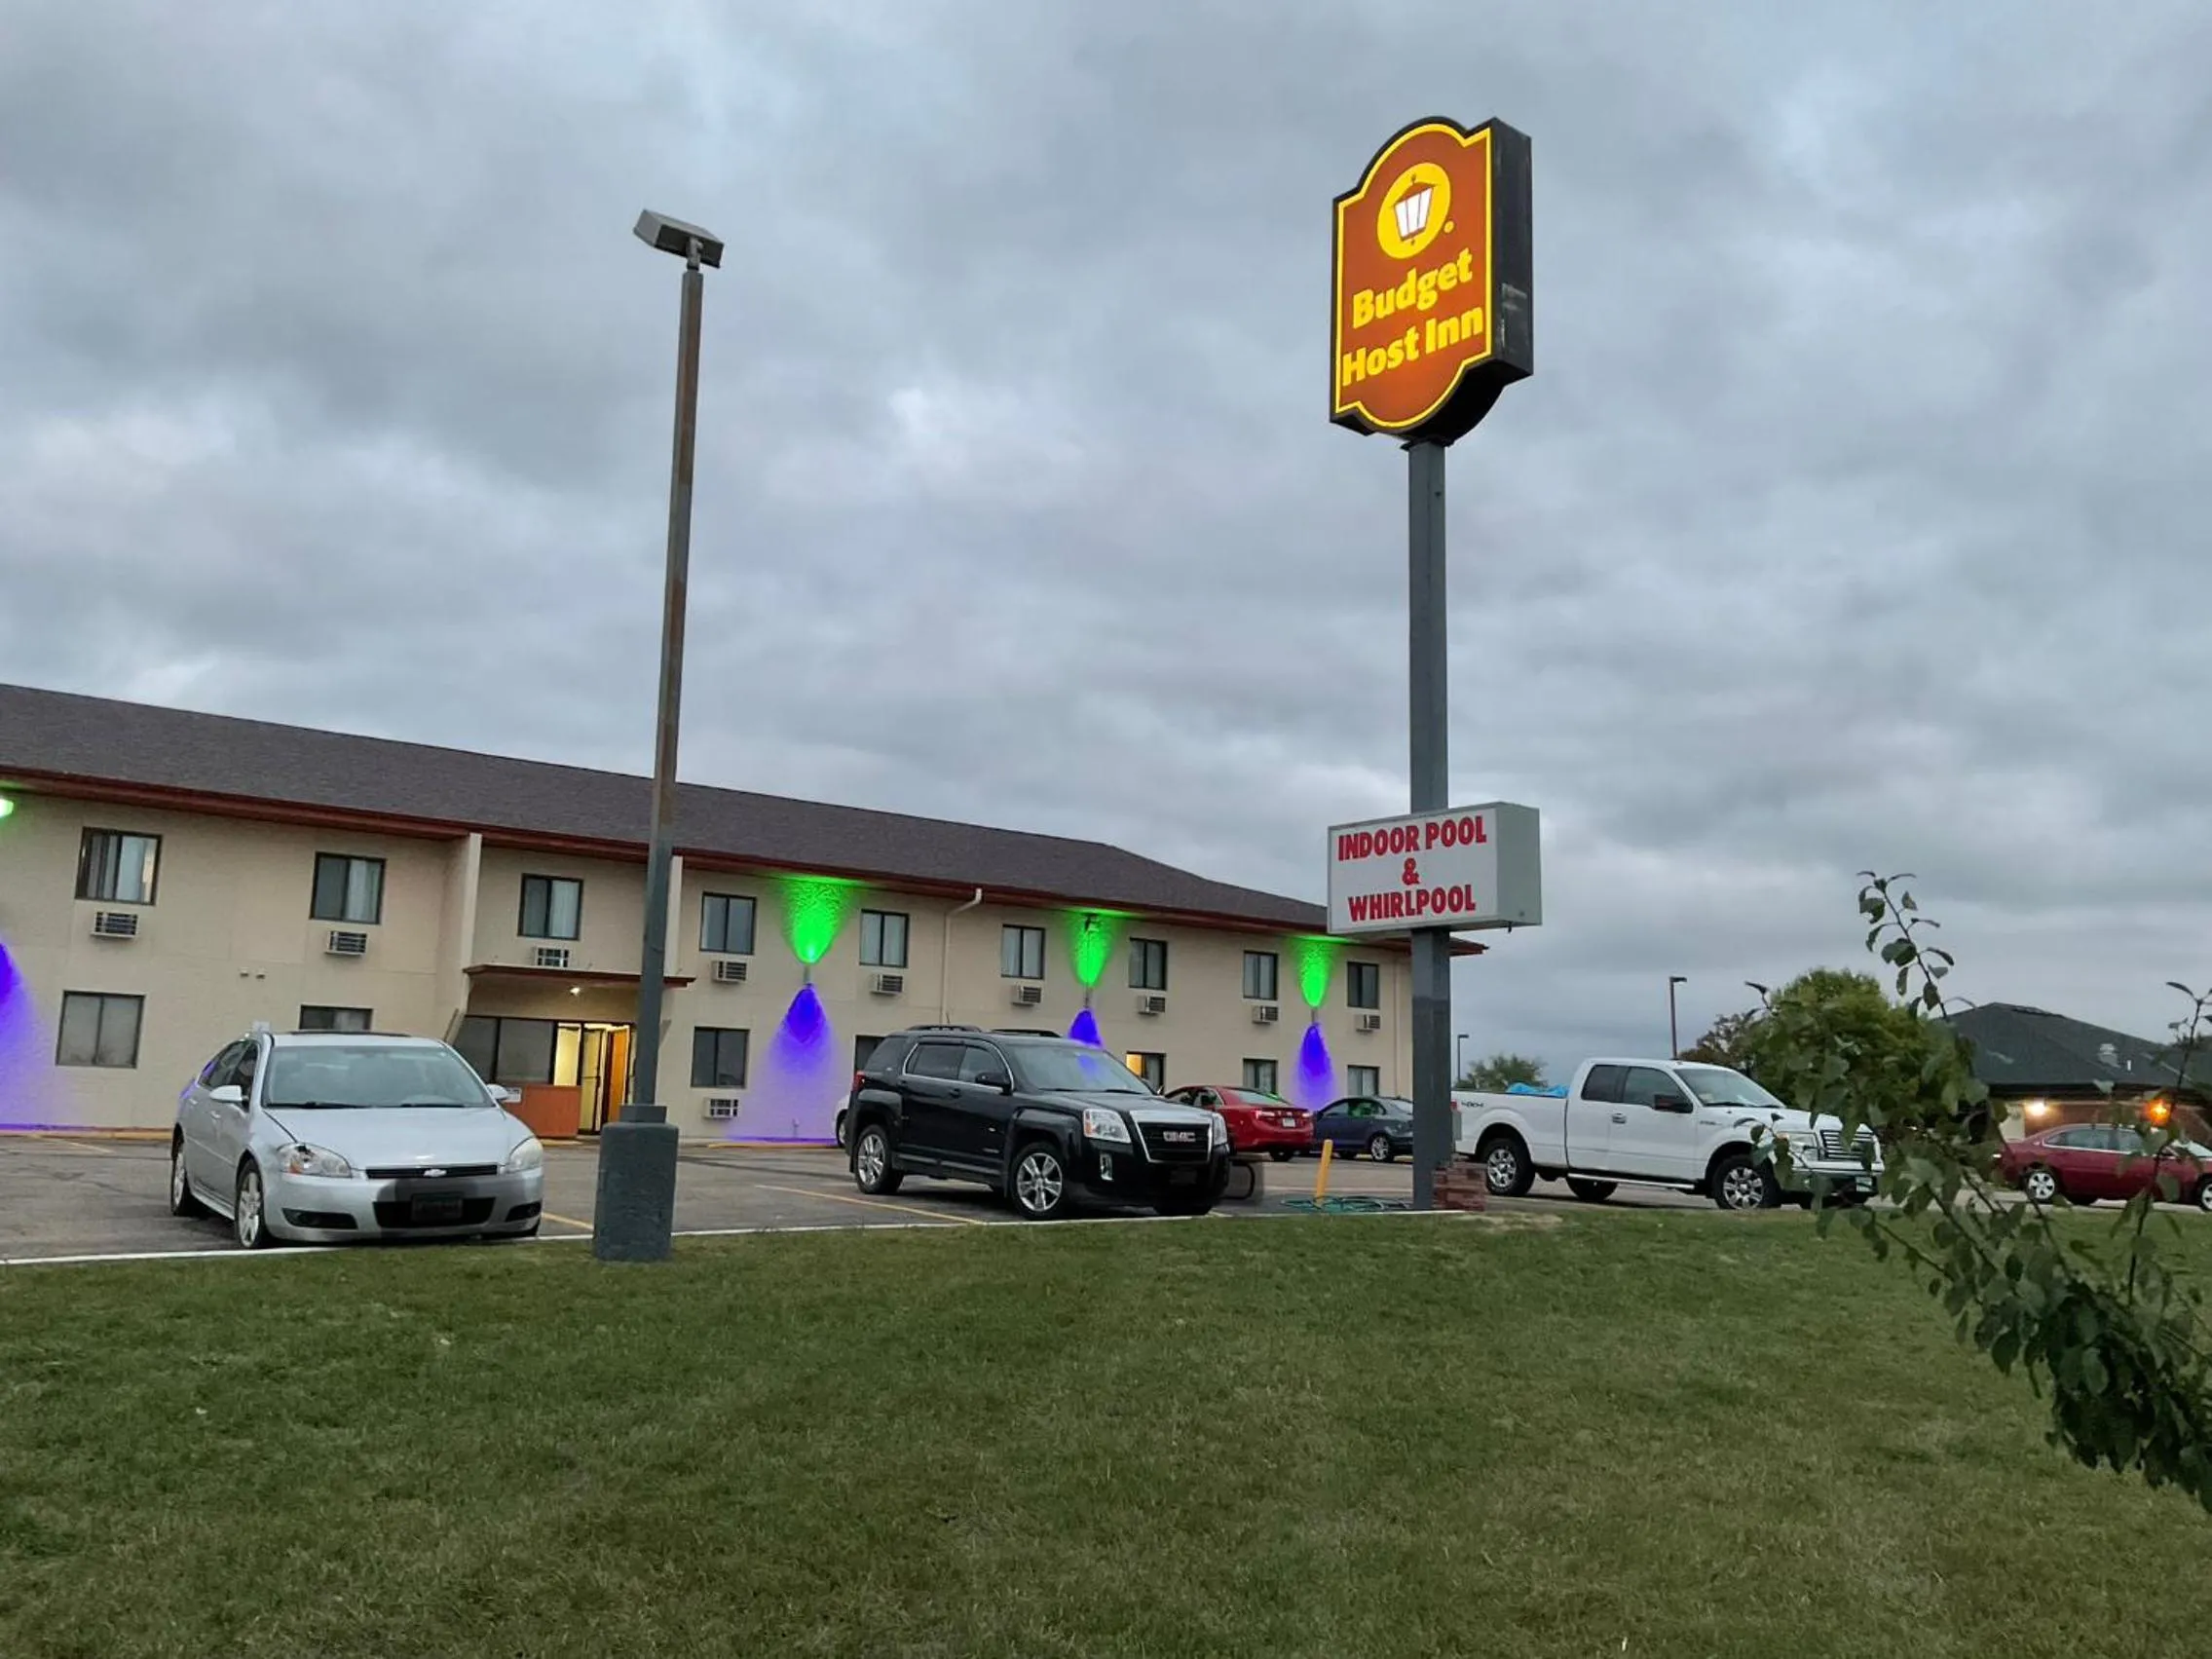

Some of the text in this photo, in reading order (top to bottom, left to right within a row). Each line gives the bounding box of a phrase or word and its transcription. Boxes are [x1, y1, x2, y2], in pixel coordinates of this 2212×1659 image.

[1352, 247, 1473, 329] Budget
[1341, 306, 1483, 387] Host Inn
[1337, 815, 1487, 861] INDOOR POOL
[1402, 857, 1420, 886] &
[1348, 885, 1476, 922] WHIRLPOOL
[1163, 1131, 1196, 1142] GMC
